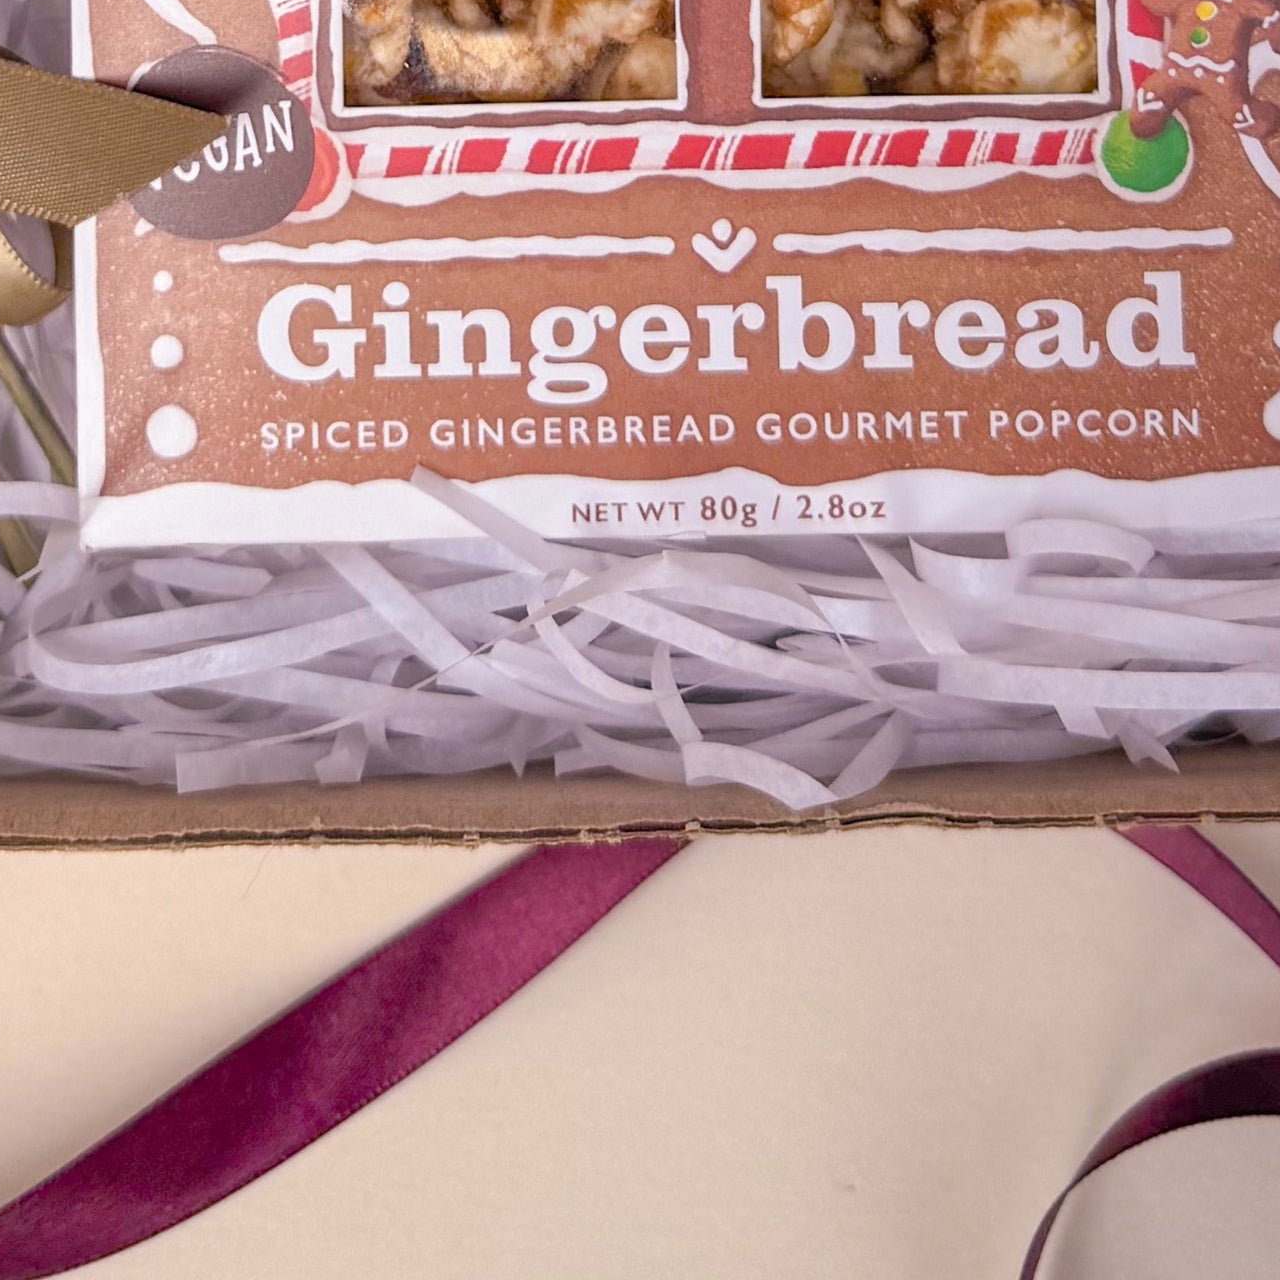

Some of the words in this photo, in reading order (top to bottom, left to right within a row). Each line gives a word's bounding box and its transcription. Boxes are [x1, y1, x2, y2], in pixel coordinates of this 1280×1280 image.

[256, 271, 1197, 407] Gingerbread
[259, 420, 410, 451] SPICED
[429, 414, 735, 448] GINGERBREAD
[755, 410, 968, 441] GOURMET
[988, 407, 1201, 440] POPCORN
[571, 502, 628, 523] NET
[636, 501, 686, 522] WT
[699, 495, 758, 528] 80g
[771, 494, 782, 521] /
[795, 493, 887, 520] 2.8oz
